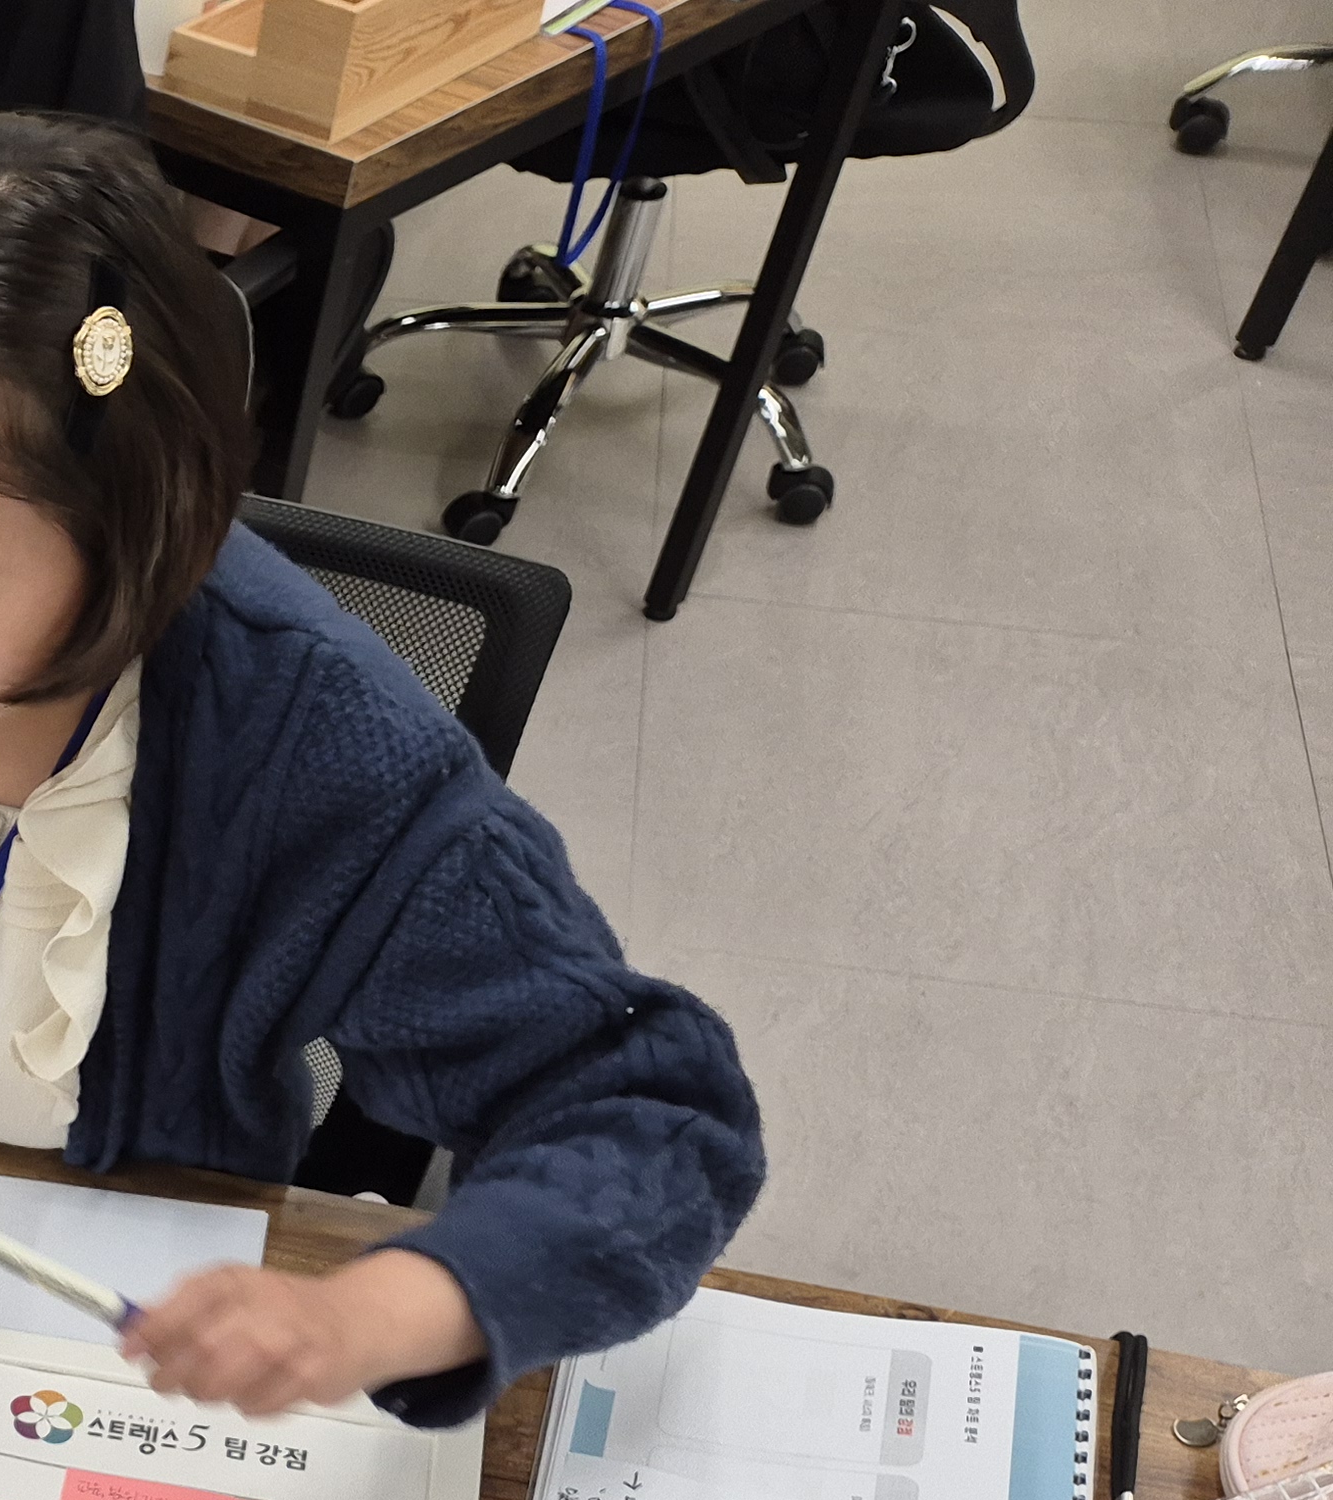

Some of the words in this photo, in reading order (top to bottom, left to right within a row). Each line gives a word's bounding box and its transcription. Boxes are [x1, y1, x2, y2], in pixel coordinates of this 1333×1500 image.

[901, 1380, 917, 1397] 우리
[899, 1399, 915, 1416] 팀의
[224, 1436, 248, 1460] 팀
[256, 1443, 308, 1471] 강점
